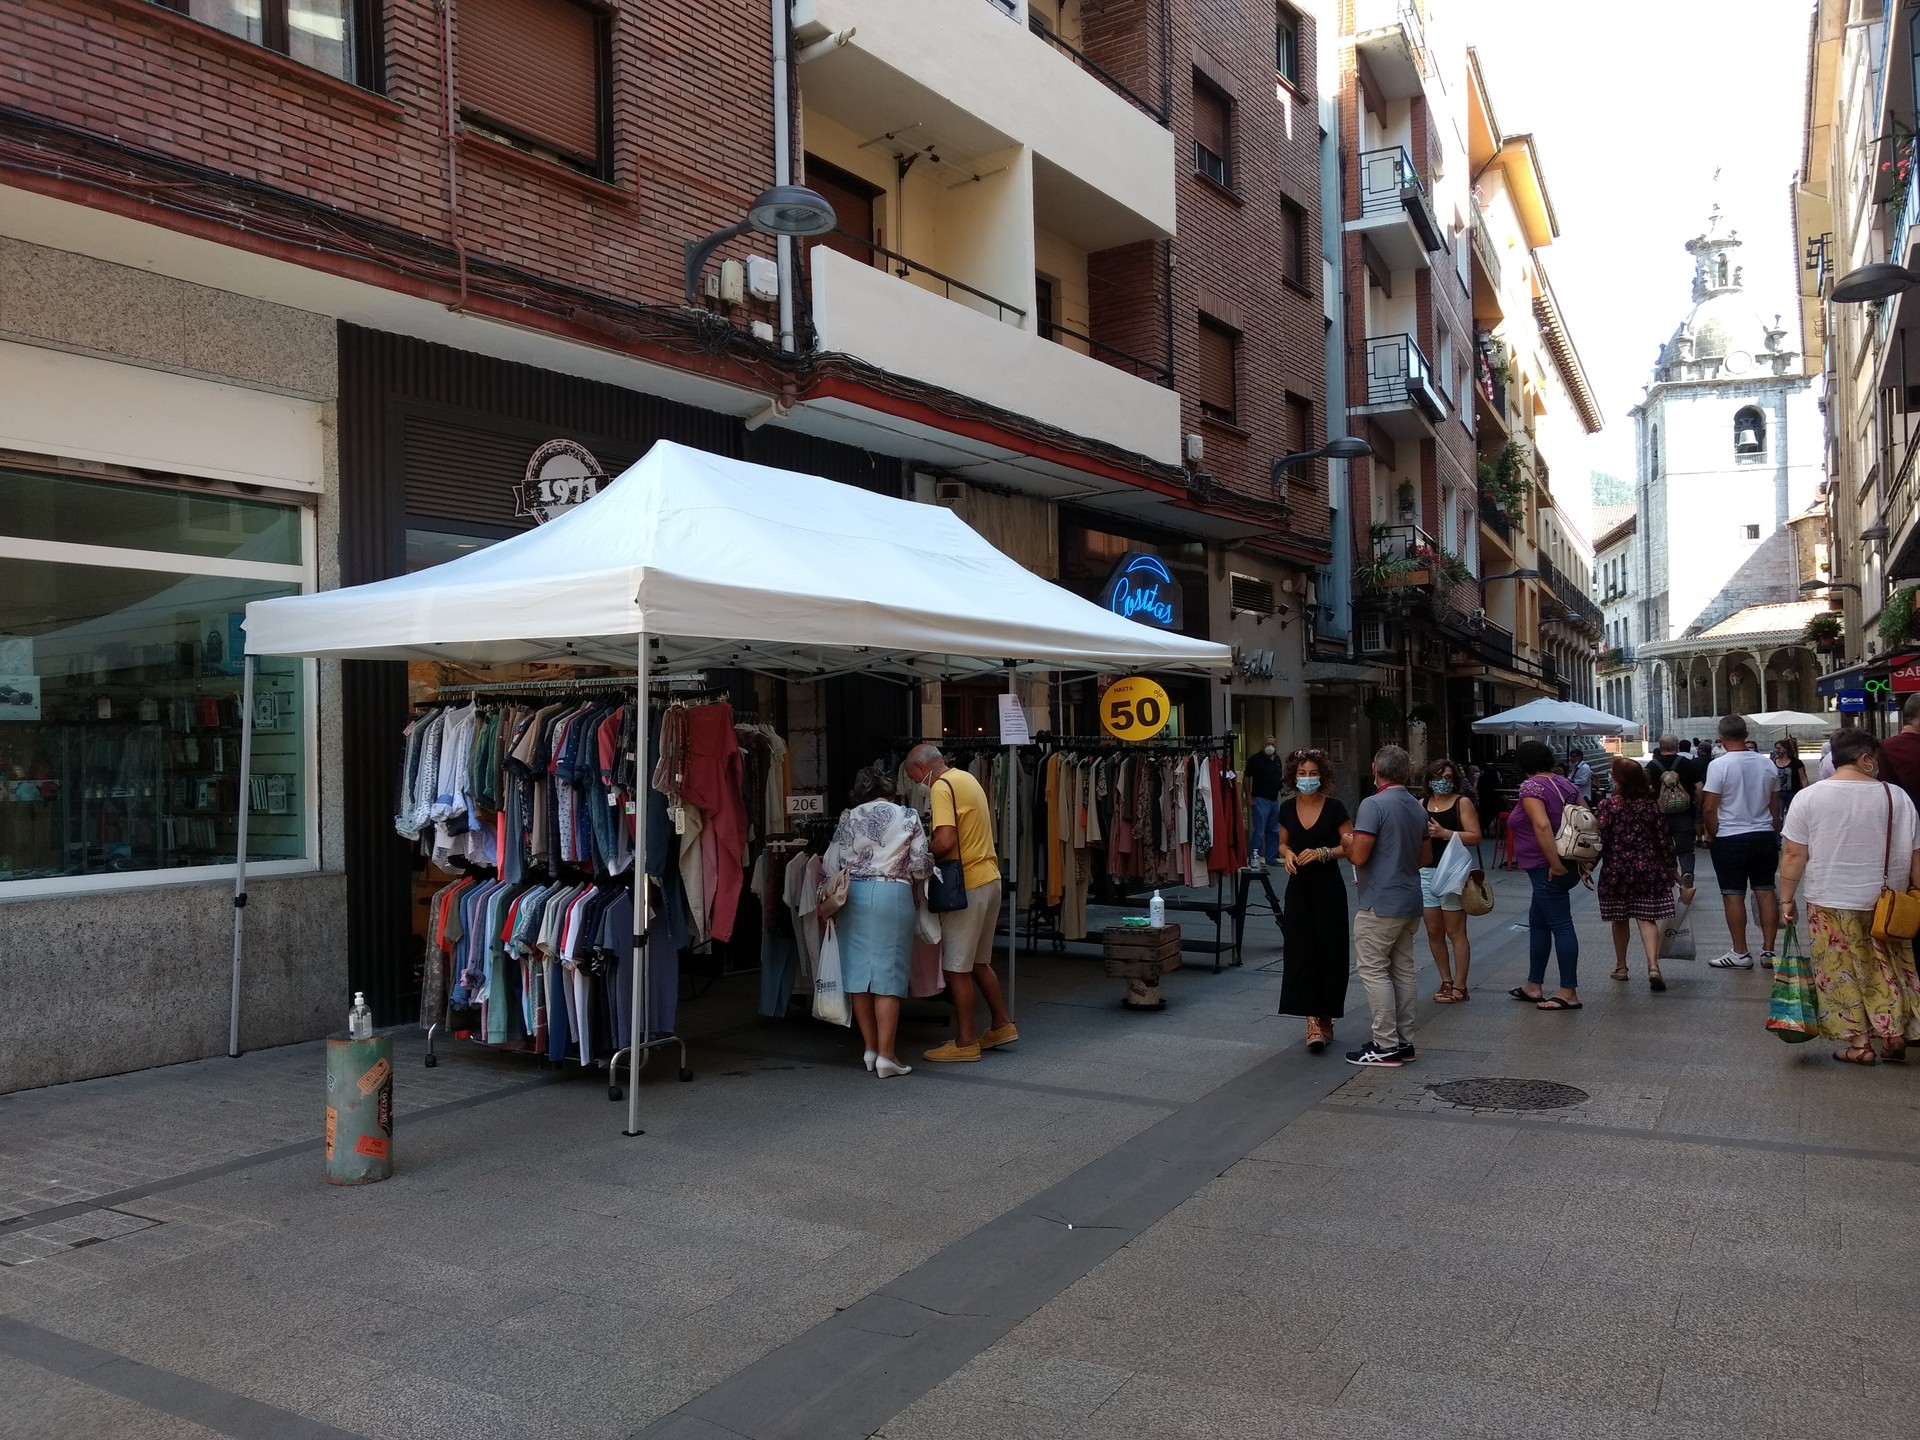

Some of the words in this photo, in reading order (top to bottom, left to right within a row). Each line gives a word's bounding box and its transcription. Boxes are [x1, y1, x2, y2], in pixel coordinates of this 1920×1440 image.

[537, 477, 598, 505] 1971
[1111, 577, 1173, 624] Cositas
[1113, 685, 1134, 693] HASTA
[1110, 696, 1161, 731] 50
[792, 798, 818, 811] 20€
